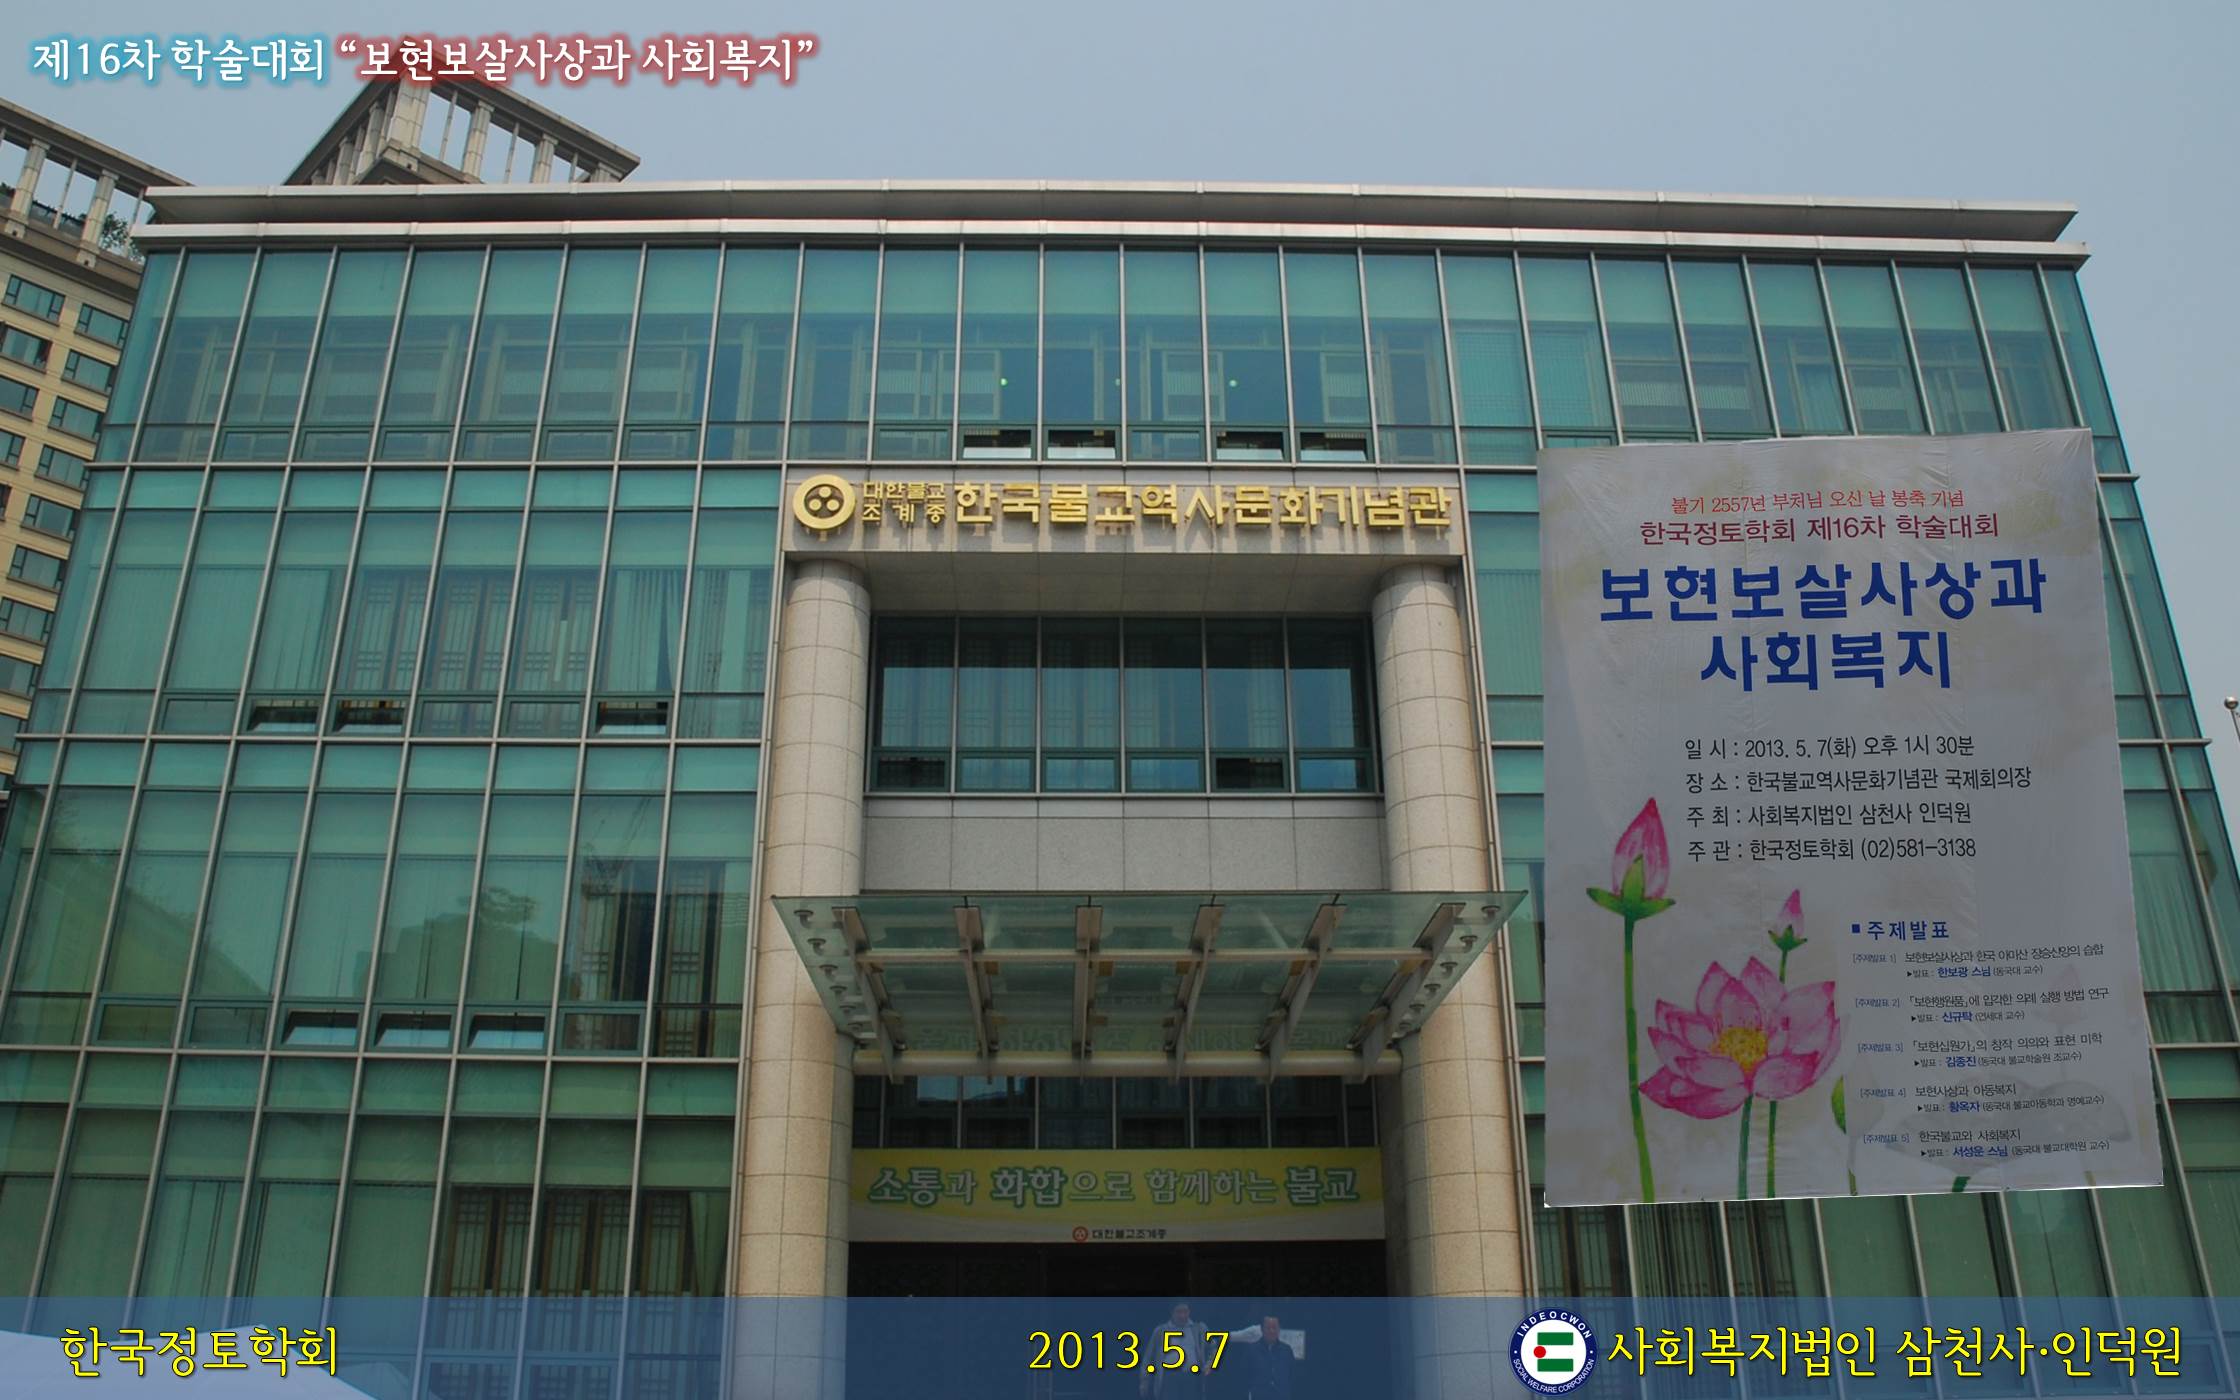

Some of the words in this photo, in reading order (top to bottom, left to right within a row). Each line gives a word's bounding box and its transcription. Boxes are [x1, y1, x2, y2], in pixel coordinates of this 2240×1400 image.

[863, 481, 945, 500] 대한불교
[955, 482, 1452, 526] 한국불교역사문화기념관
[1672, 497, 1704, 515] 불기
[1712, 494, 1765, 513] 2557년
[1773, 492, 1822, 510] 부처님
[1831, 491, 1861, 508] 오신
[1869, 490, 1886, 508] 날
[1891, 490, 1926, 508] 봉축
[1932, 489, 1963, 508] 기념
[1640, 518, 1795, 546] 한국정토학회
[1807, 515, 1886, 541] 제16차
[1896, 513, 1998, 539] 학술대회
[1600, 558, 2047, 622] 보현보살사상과
[1700, 630, 1952, 692] 사회복지
[1817, 737, 1856, 758] 7(화)
[1864, 735, 1899, 756] 오후
[1906, 734, 1929, 755] 1시
[1936, 735, 1975, 756] 30분
[1747, 768, 1938, 792] 한국불교역사문화기념관
[1945, 766, 2031, 790] 국제회의장
[1748, 804, 1852, 826] 사회복지법인
[1860, 803, 1912, 825] 삼천사
[1919, 802, 1971, 824] 인덕원
[1749, 839, 1854, 861] 한국정토학회
[1861, 838, 1976, 860] (02)581-3138
[1867, 920, 1949, 941] 주제발표
[1976, 950, 1995, 962] 한국
[1937, 967, 1968, 978] 한보광
[1971, 965, 1991, 976] 스님
[1983, 993, 2012, 1006] 입각한
[2088, 987, 2110, 1000] 연구
[1942, 1011, 1973, 1022] 신규탁
[1991, 1037, 2013, 1051] 창작
[2017, 1035, 2049, 1049] 의의와
[2054, 1034, 2076, 1047] 표현
[2081, 1032, 2103, 1045] 미학
[1915, 1085, 1969, 1098] 보현사상과
[1973, 1083, 2016, 1097] 아동복지
[1919, 1130, 1972, 1143] 한국불교와
[1977, 1128, 2021, 1142] 사회복지
[1987, 1145, 2008, 1157] 스님
[869, 1166, 977, 1204] 소통과
[992, 1167, 1135, 1207] 화합으로
[1146, 1168, 1277, 1205] 함께하는
[1285, 1166, 1359, 1204] 불교
